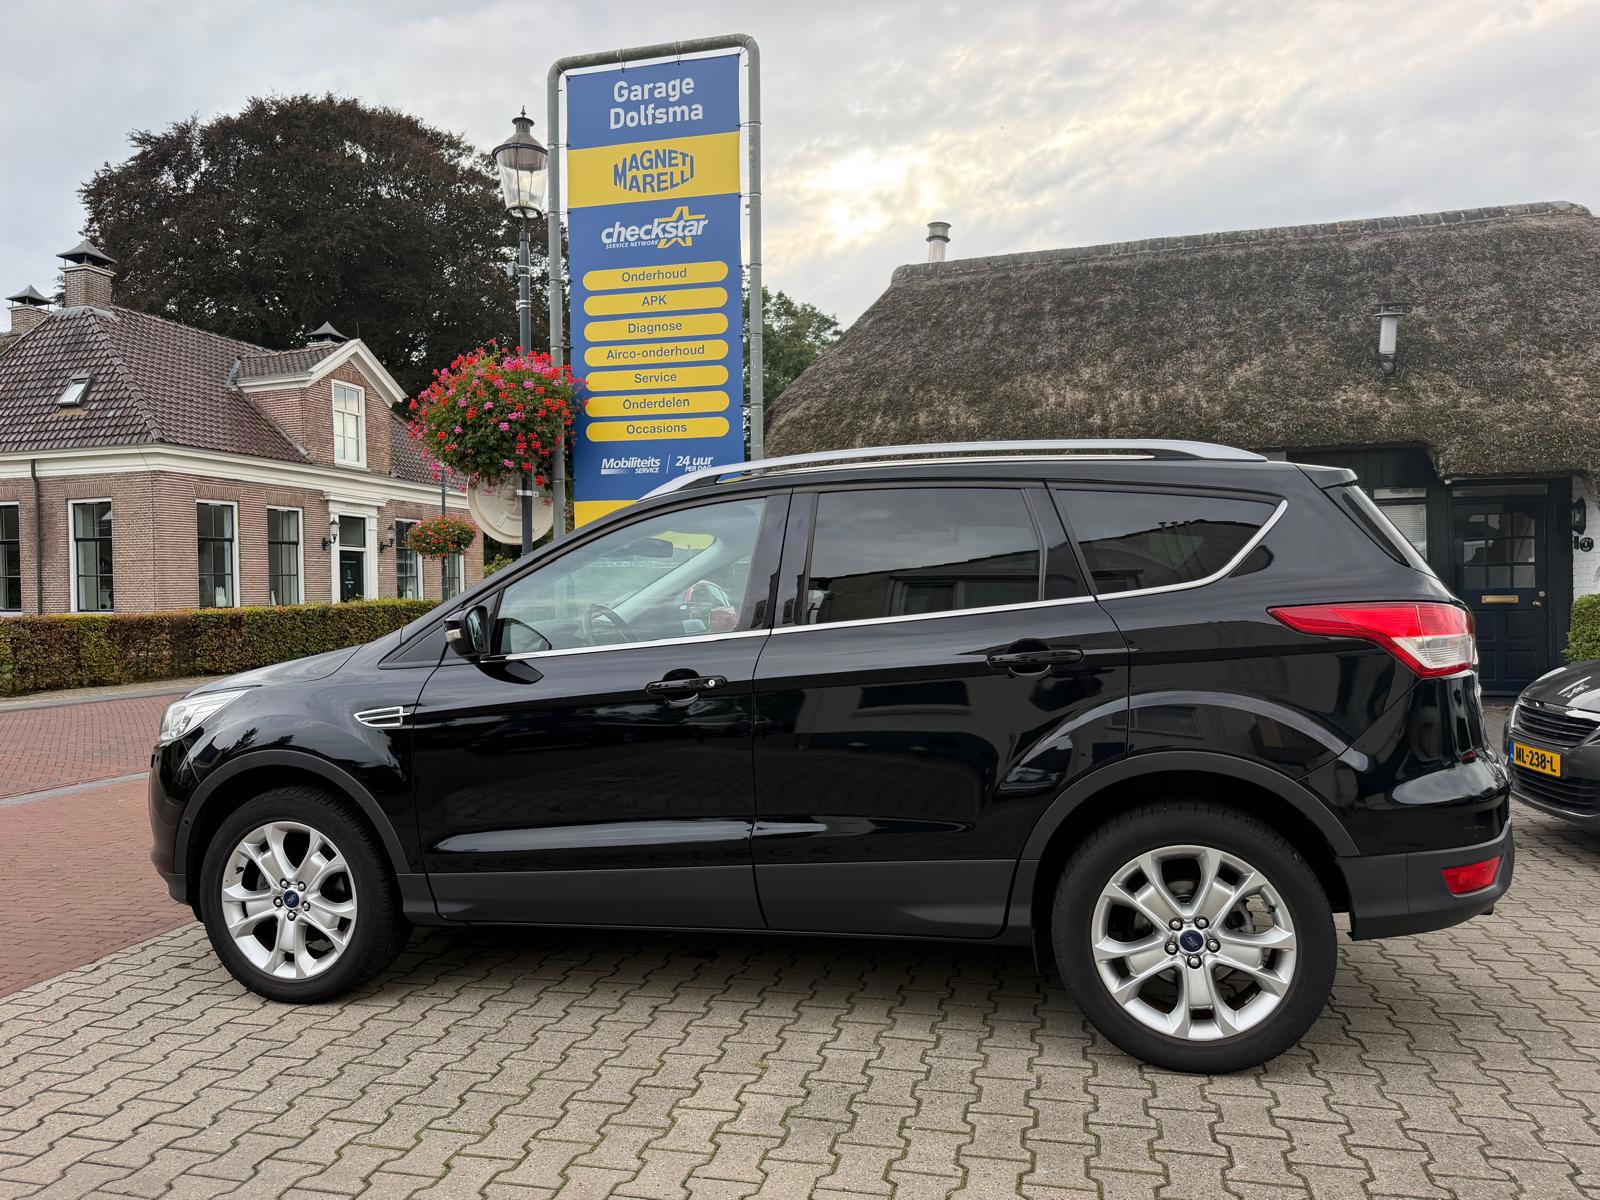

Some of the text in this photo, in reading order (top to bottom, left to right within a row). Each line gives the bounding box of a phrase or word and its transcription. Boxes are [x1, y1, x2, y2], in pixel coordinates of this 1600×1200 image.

[613, 77, 695, 103] Garage
[610, 104, 703, 130] Dolfsma
[613, 148, 694, 180] MAGNETI
[601, 218, 708, 244] checkstar
[606, 239, 660, 250] SERVICE NETWORK
[621, 268, 687, 283] Onderhoud
[642, 295, 667, 307] APK
[627, 322, 683, 335] Diagnose
[606, 345, 705, 361] Airco-onderhoud
[634, 372, 677, 384] Service
[622, 398, 690, 410] Onderdelen
[626, 423, 687, 435] Occasions
[601, 455, 713, 469] Mobiliteits 24 uur
[635, 466, 660, 474] SERVICE
